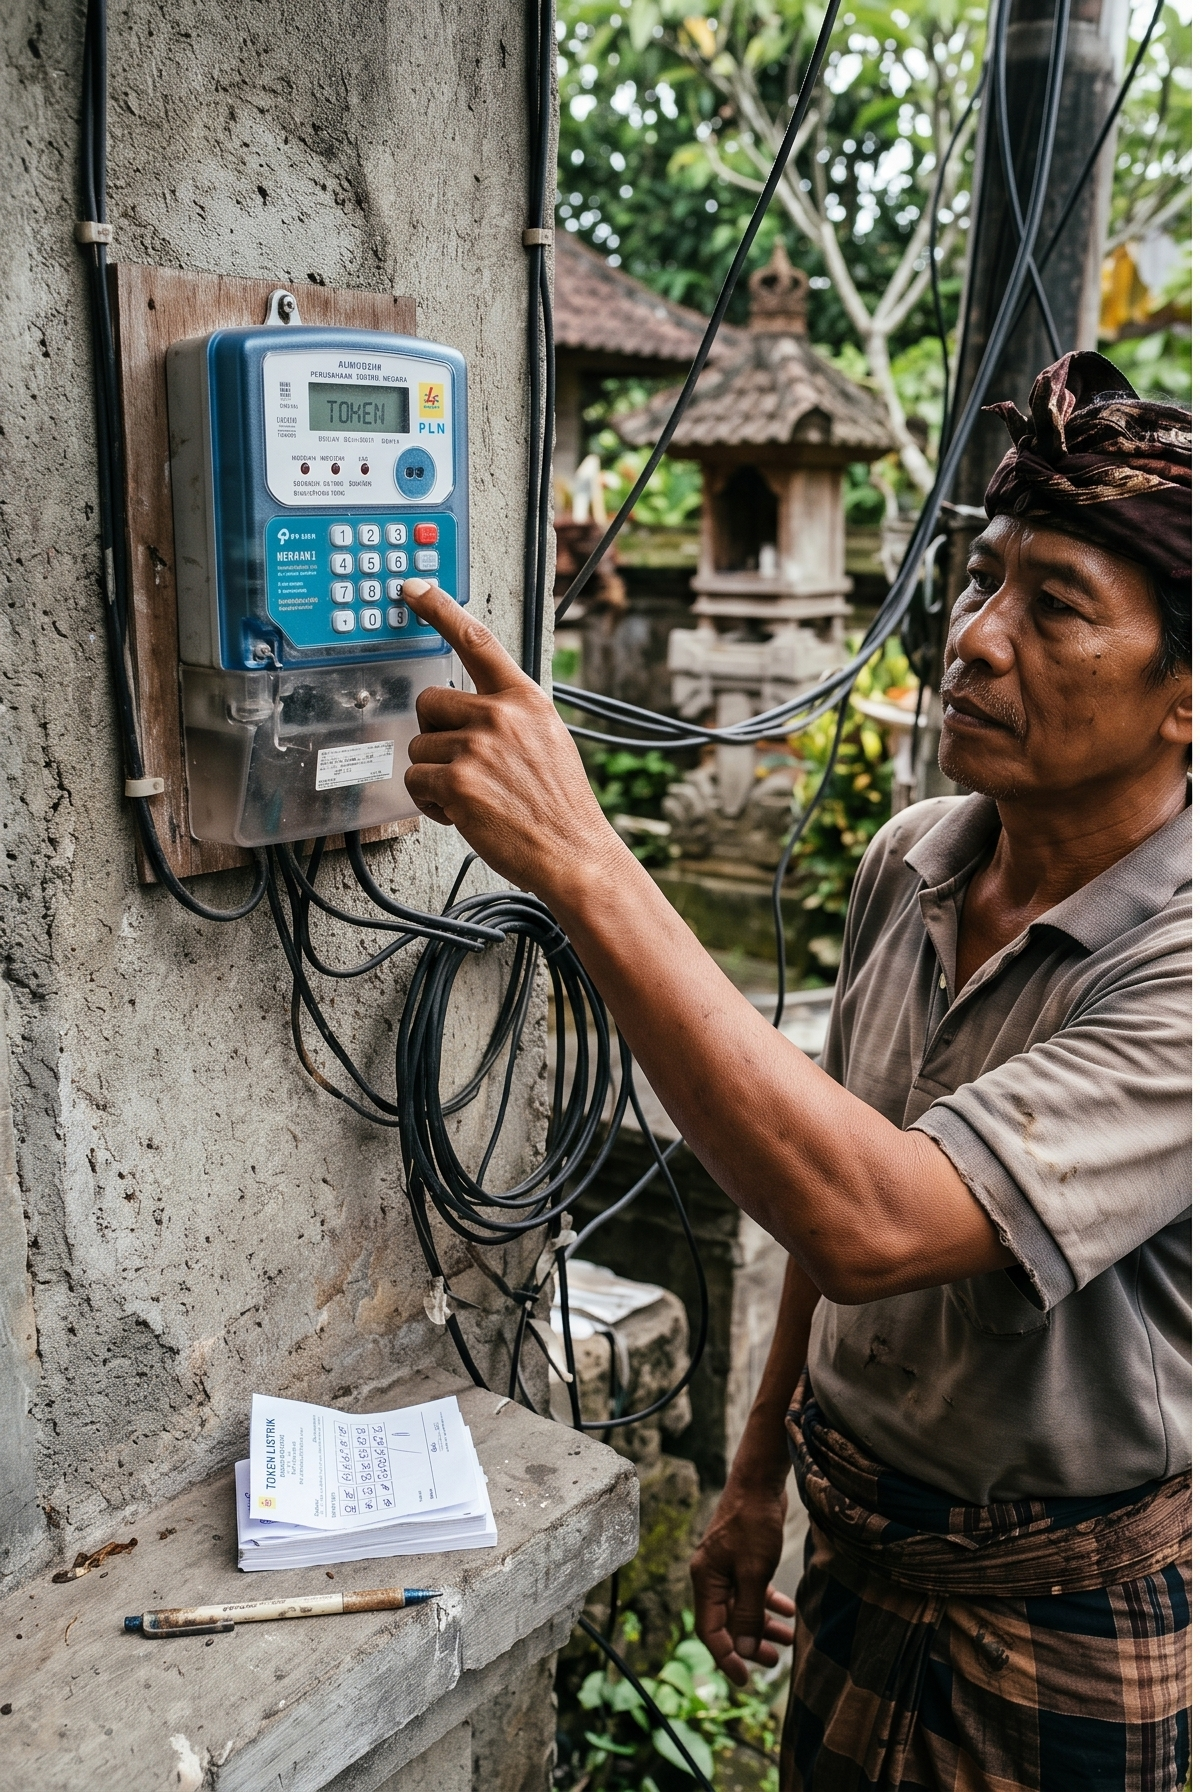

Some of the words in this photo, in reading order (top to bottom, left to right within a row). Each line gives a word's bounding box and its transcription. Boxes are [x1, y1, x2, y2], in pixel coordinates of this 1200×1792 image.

[310, 371, 353, 380] PERUSAHAAN
[382, 375, 408, 383] NEGARA
[419, 422, 445, 434] PLN
[367, 528, 375, 542] 2
[394, 528, 402, 541] 3
[339, 557, 347, 571] 4
[367, 557, 375, 570] 5
[394, 555, 402, 569] 6
[340, 585, 348, 599] 7
[368, 584, 376, 598] 8
[395, 583, 403, 597] 9
[369, 613, 377, 626] 0
[265, 1418, 276, 1454] LISTRIK
[265, 1454, 276, 1490] TOKEN
